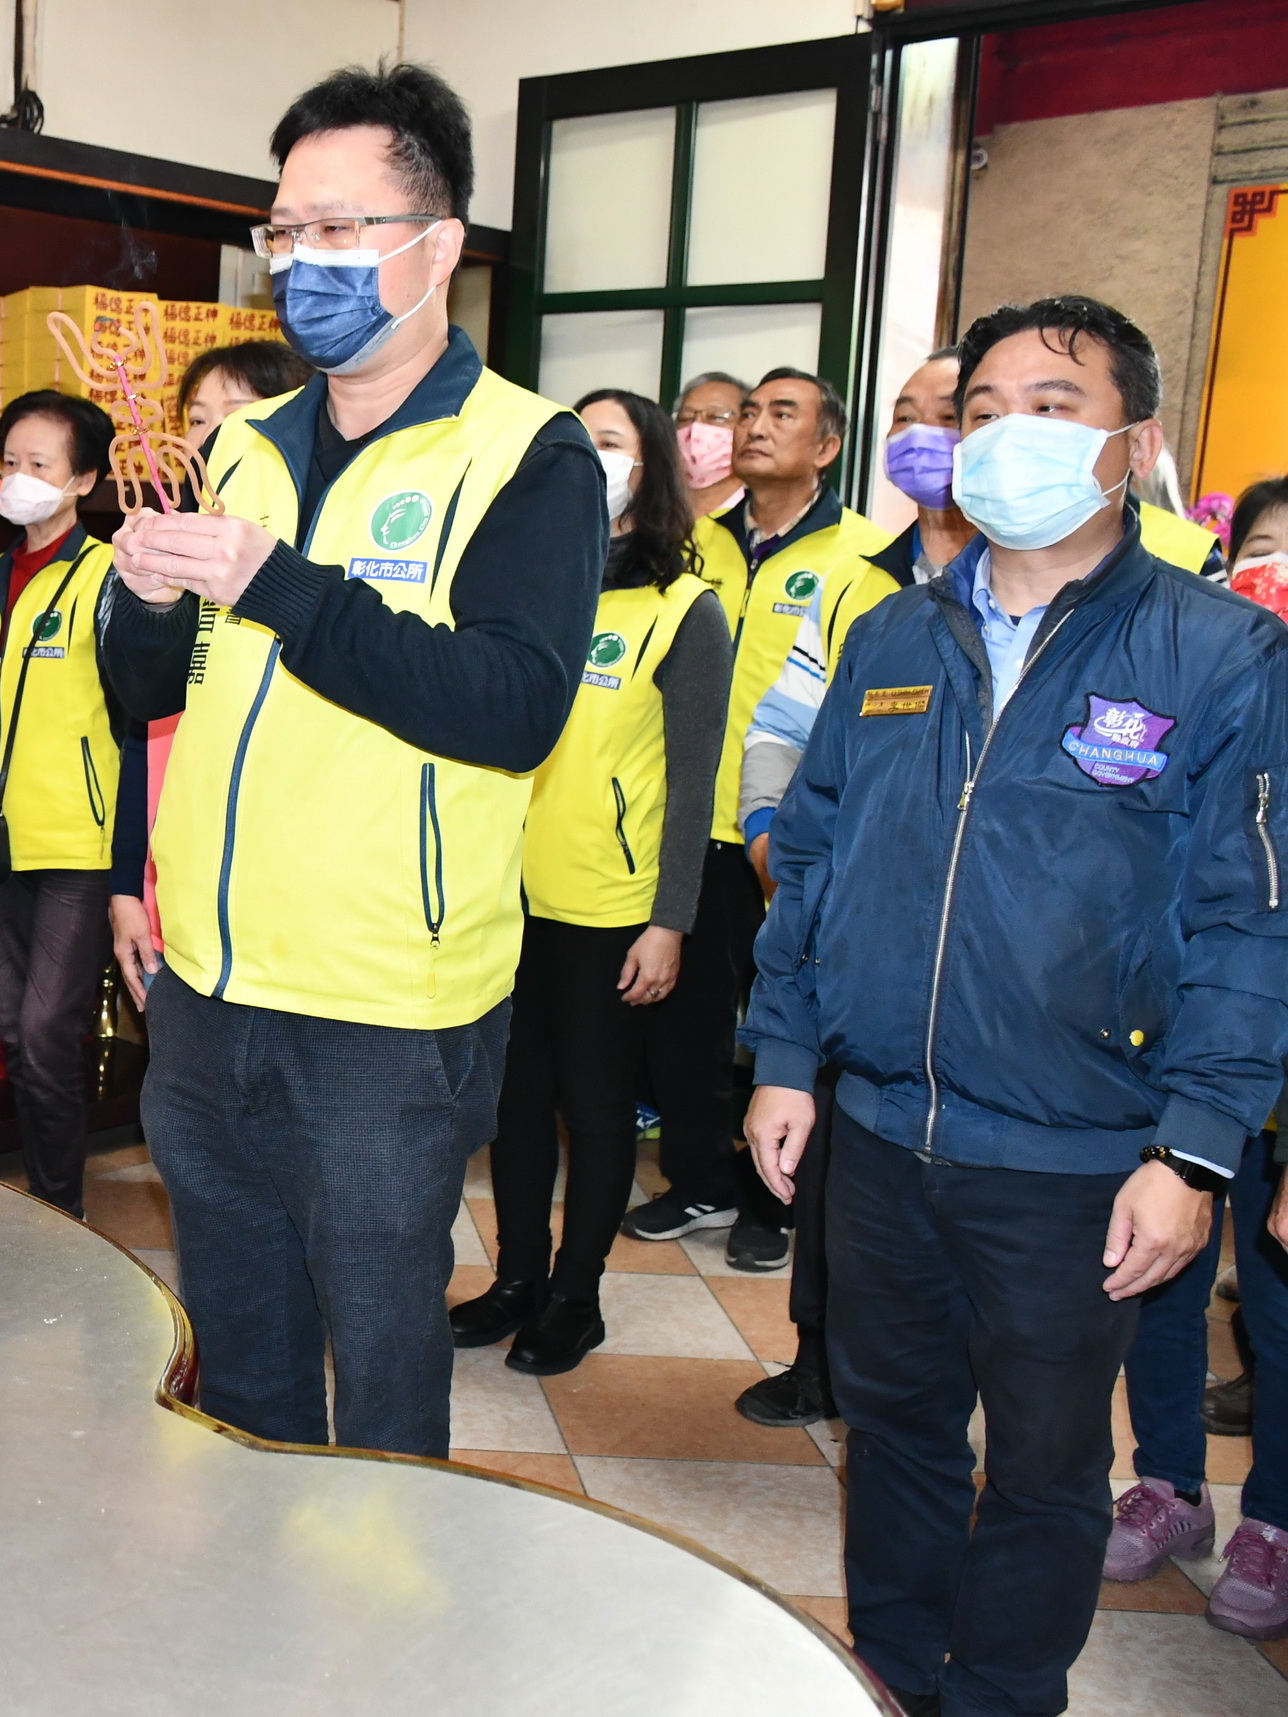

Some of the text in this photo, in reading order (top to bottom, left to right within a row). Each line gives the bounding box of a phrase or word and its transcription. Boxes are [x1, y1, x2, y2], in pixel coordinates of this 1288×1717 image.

[351, 560, 425, 581] 彰化市公所
[1102, 707, 1146, 740] 彰化
[1068, 741, 1158, 766] CHANGHUA
[1094, 763, 1120, 773] COUNTY
